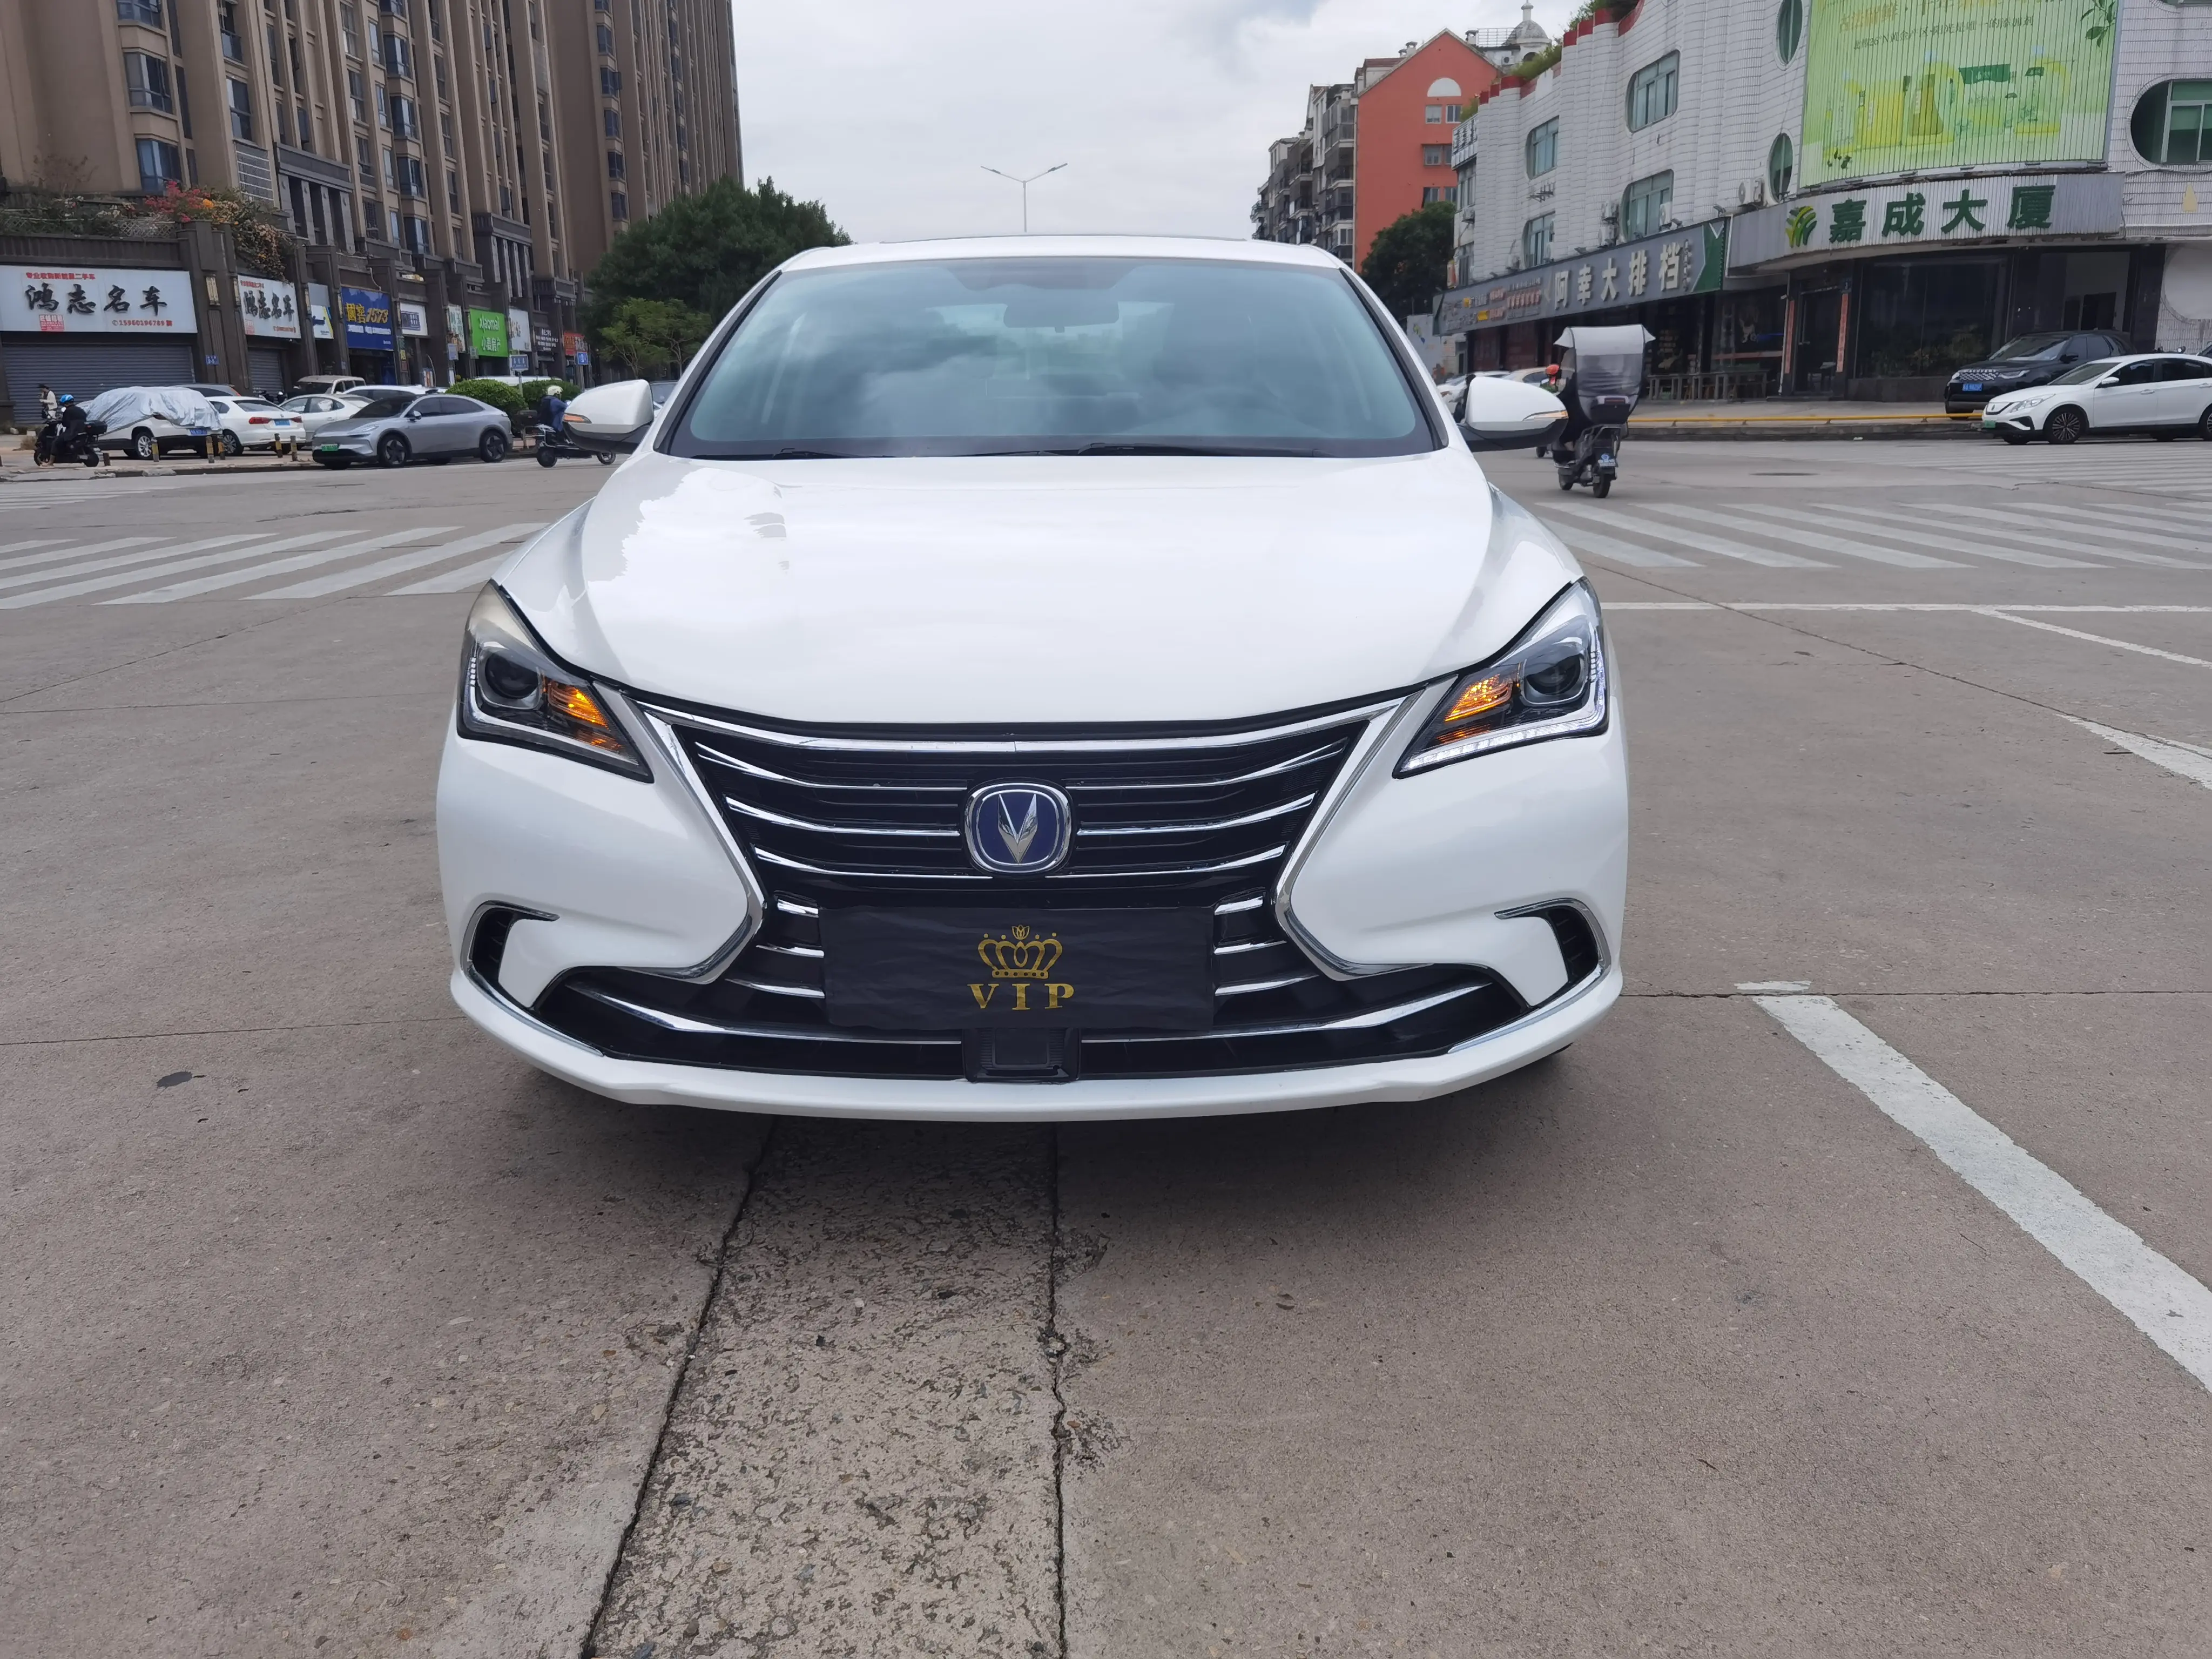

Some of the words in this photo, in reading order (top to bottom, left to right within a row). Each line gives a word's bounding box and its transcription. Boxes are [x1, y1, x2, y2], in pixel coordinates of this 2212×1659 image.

[1829, 185, 2055, 243] 嘉成大厦
[25, 282, 167, 316] 鸿志名车
[244, 290, 295, 322] 鸿志名车
[967, 983, 1074, 1010] VIP
